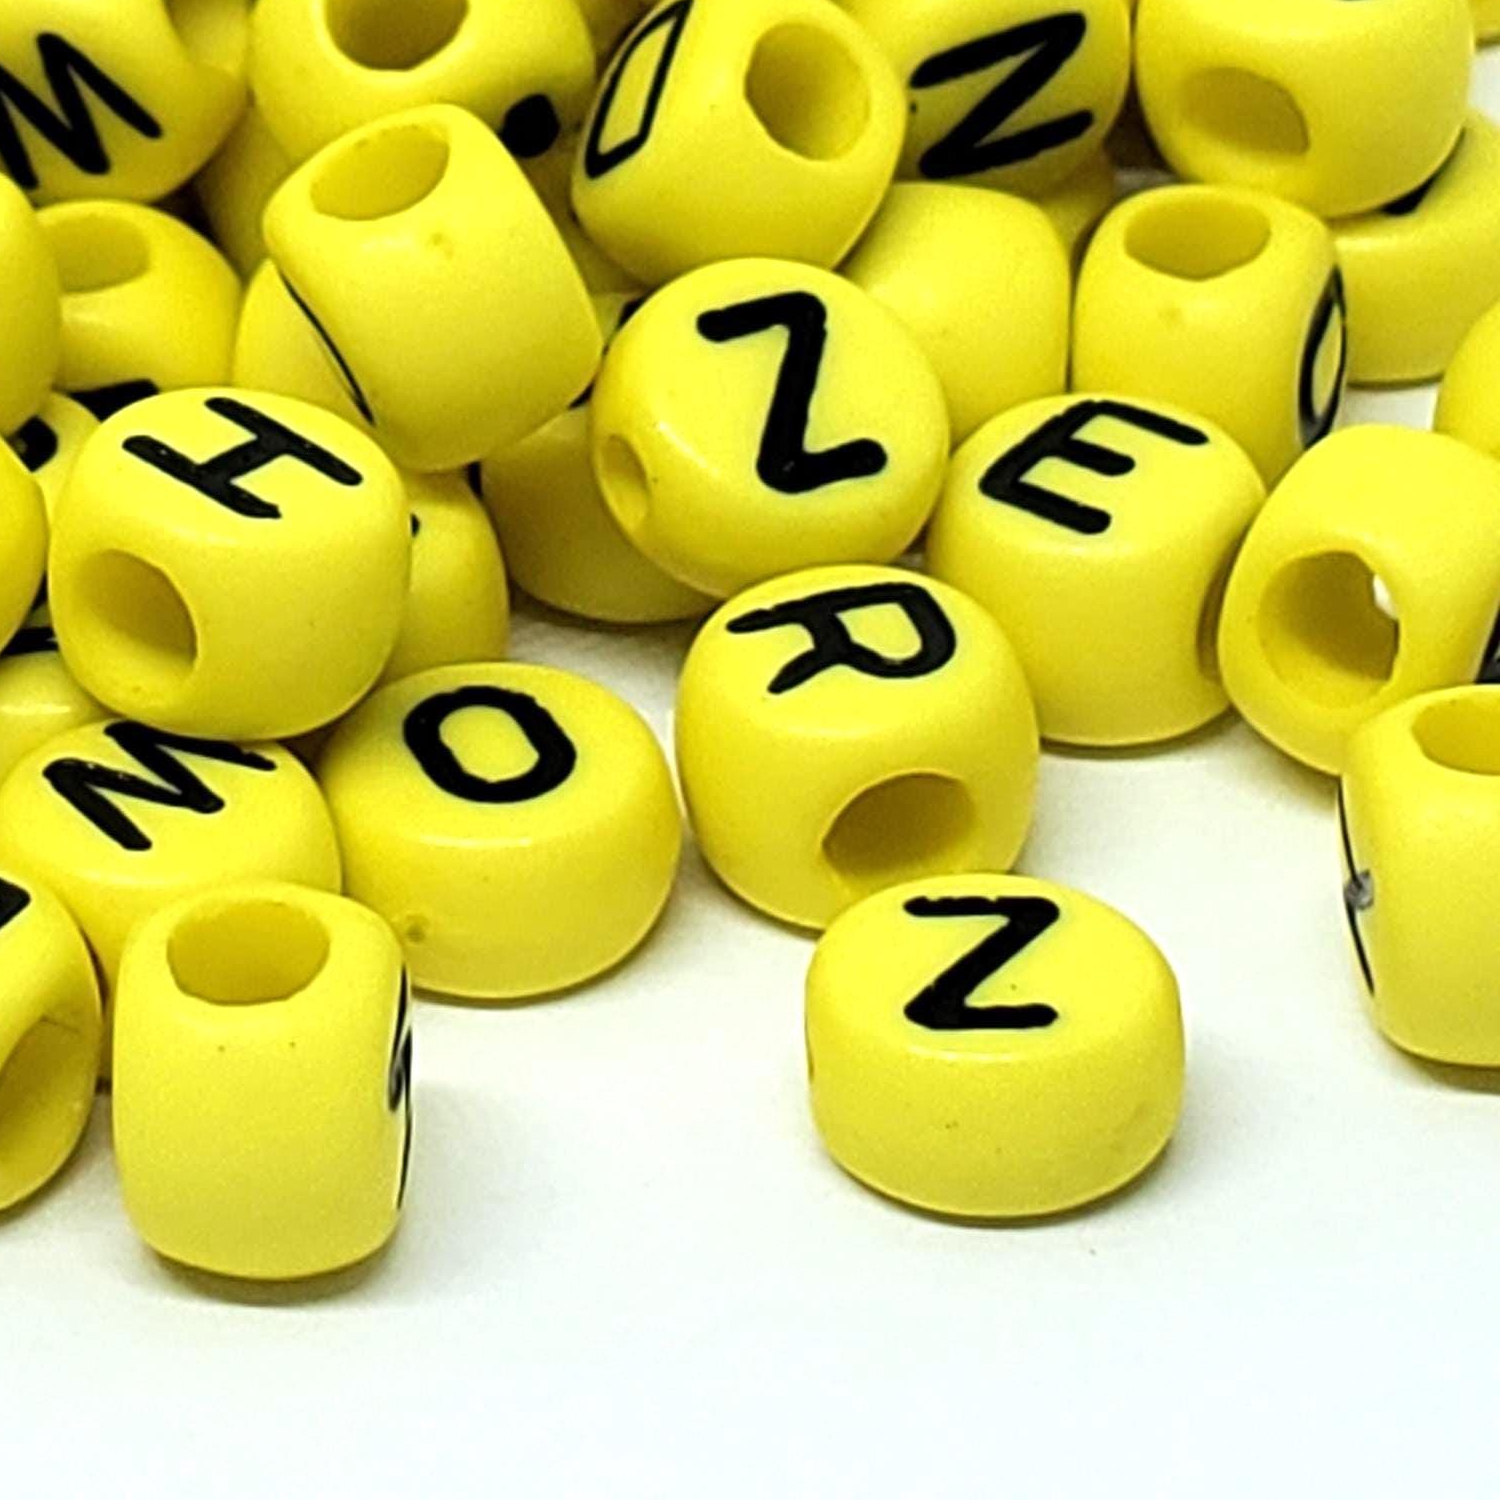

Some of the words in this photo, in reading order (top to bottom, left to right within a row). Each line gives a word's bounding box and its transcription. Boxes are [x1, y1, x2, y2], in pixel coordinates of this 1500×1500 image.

[695, 290, 889, 496] Z
[121, 396, 365, 521] H
[977, 399, 1211, 537] E
[724, 581, 958, 696] R
[401, 684, 579, 805] O
